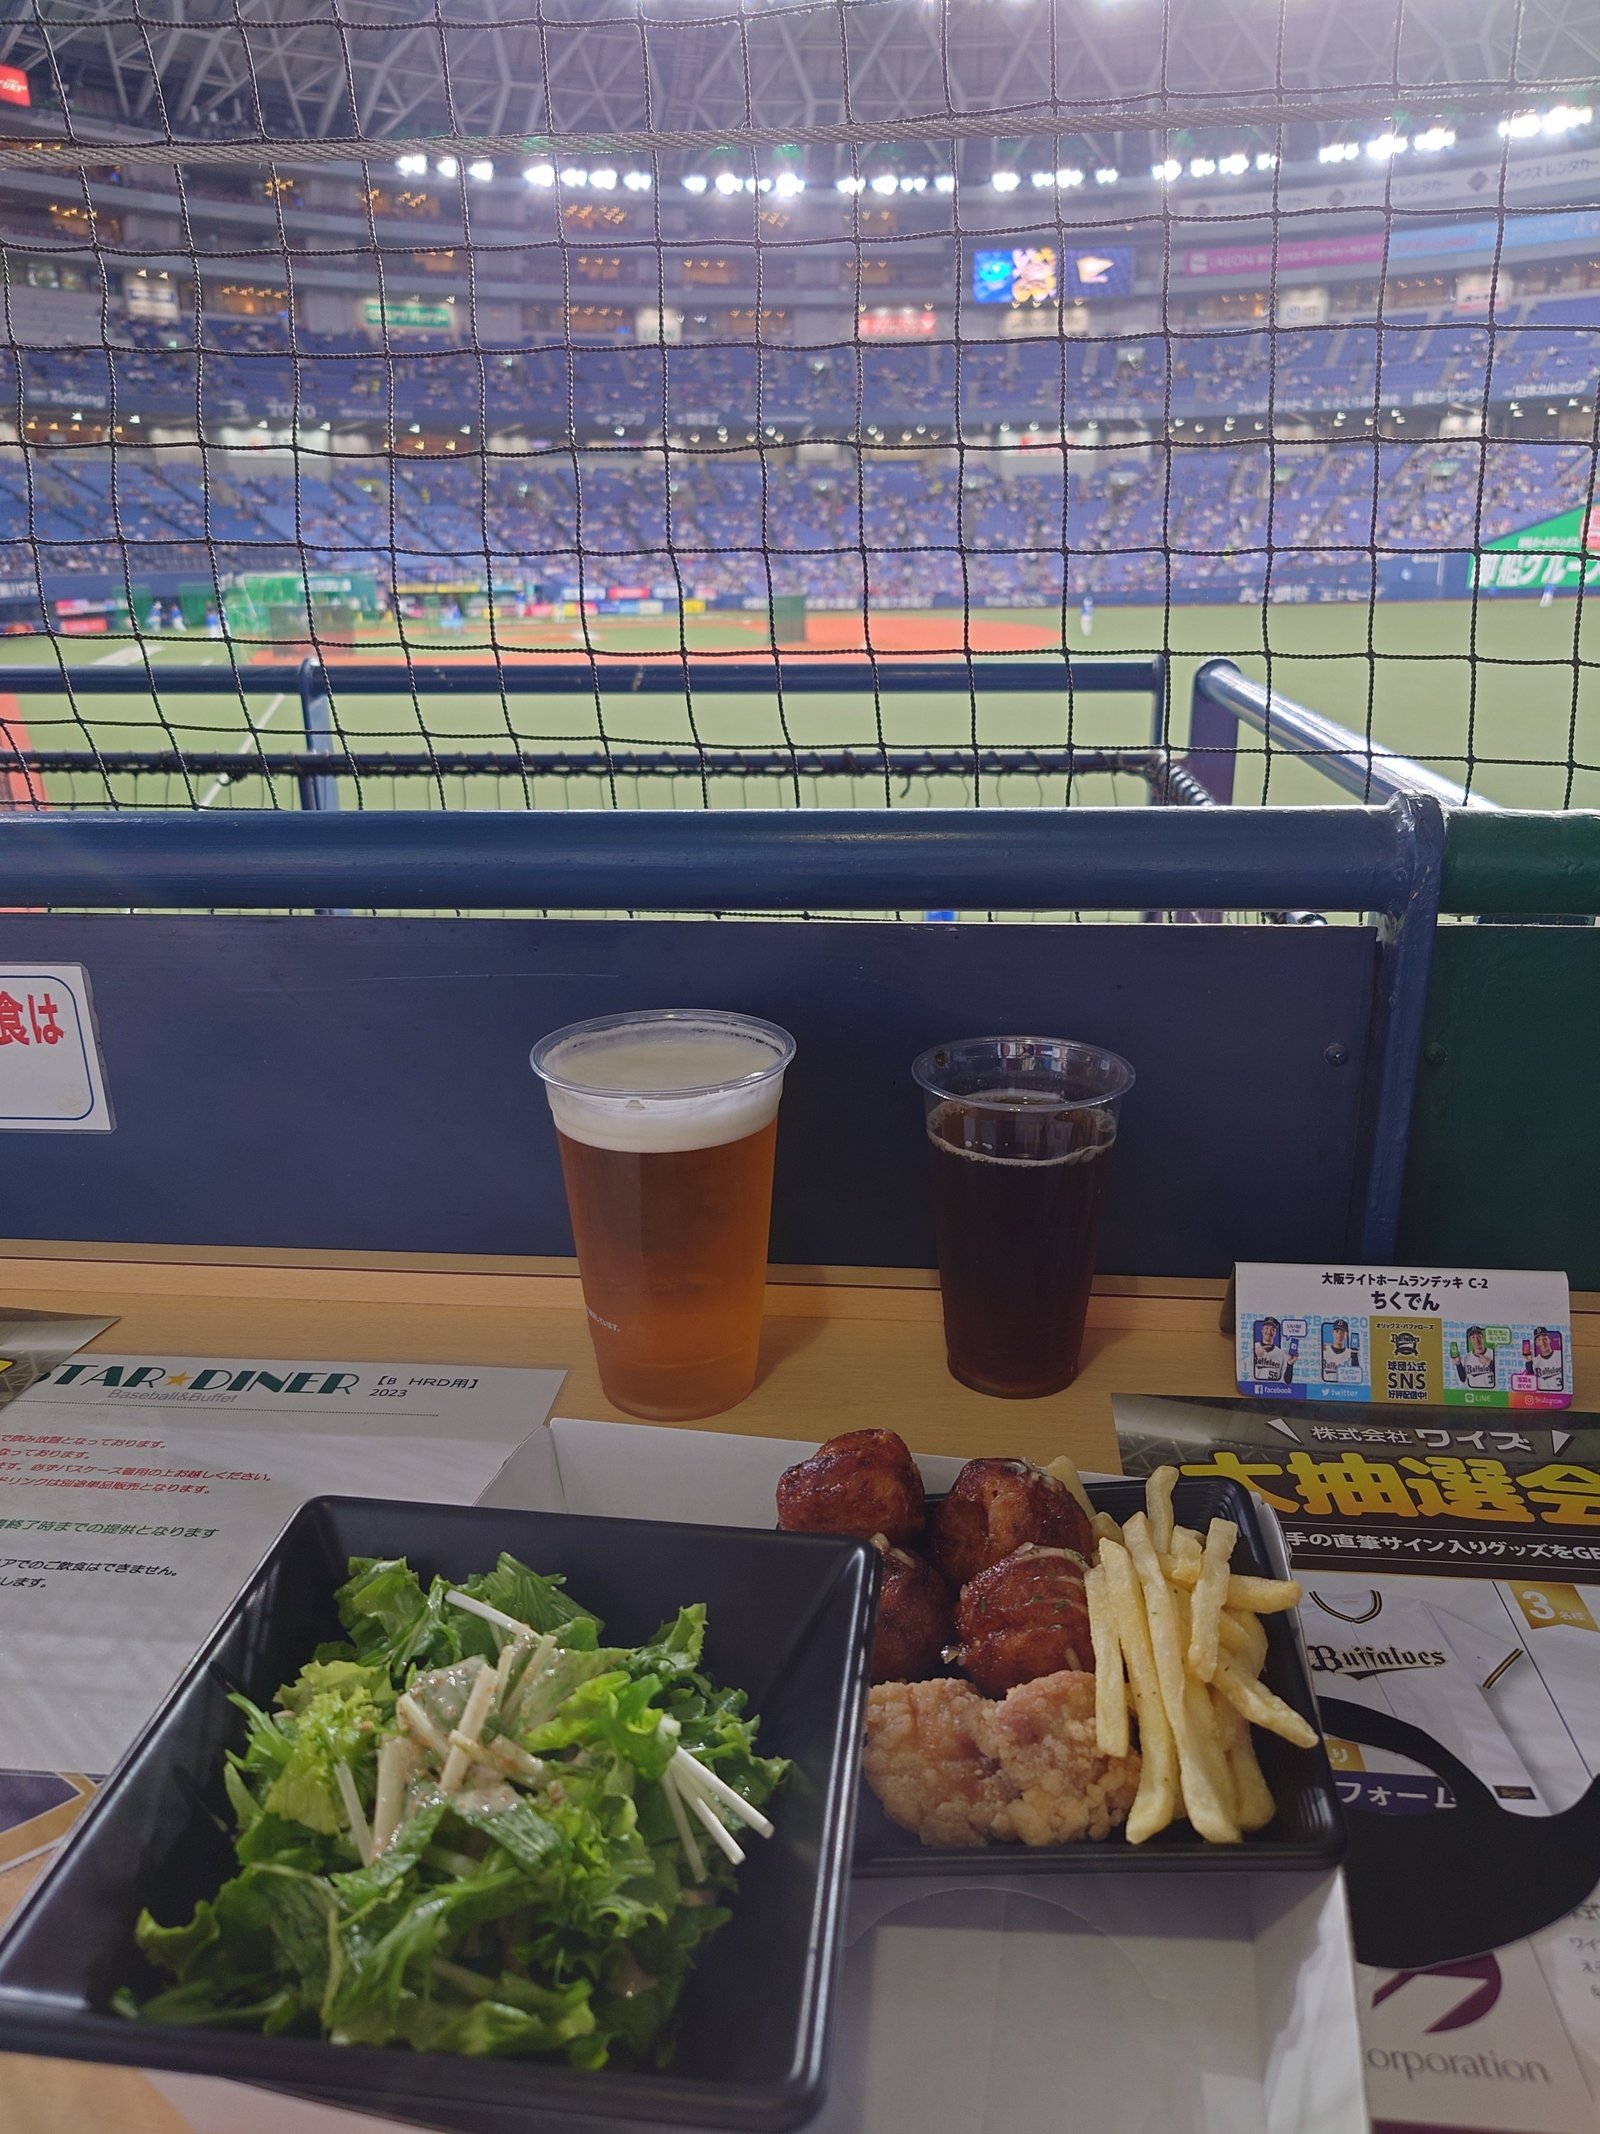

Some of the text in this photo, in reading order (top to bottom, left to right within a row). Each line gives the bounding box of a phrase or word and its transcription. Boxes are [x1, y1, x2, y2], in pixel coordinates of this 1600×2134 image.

[1322, 1272, 1489, 1289] 大阪ライトホームランデッキ C-2
[1371, 1290, 1440, 1312] ちくでん
[1387, 1361, 1427, 1372] 球団公式
[187, 1369, 360, 1395] DINER
[1264, 1386, 1292, 1394] facebook
[1387, 1372, 1426, 1390] SNS
[107, 1389, 238, 1403] Baseball&Buffet
[369, 1388, 408, 1398] 2023
[1331, 1388, 1358, 1397] twitter
[1311, 1425, 1534, 1452] 株式会社 ワイズ
[1181, 1451, 1600, 1526] 大抽選会
[1309, 1645, 1448, 1673] Buffaloes
[1366, 2047, 1550, 2083] orporation
